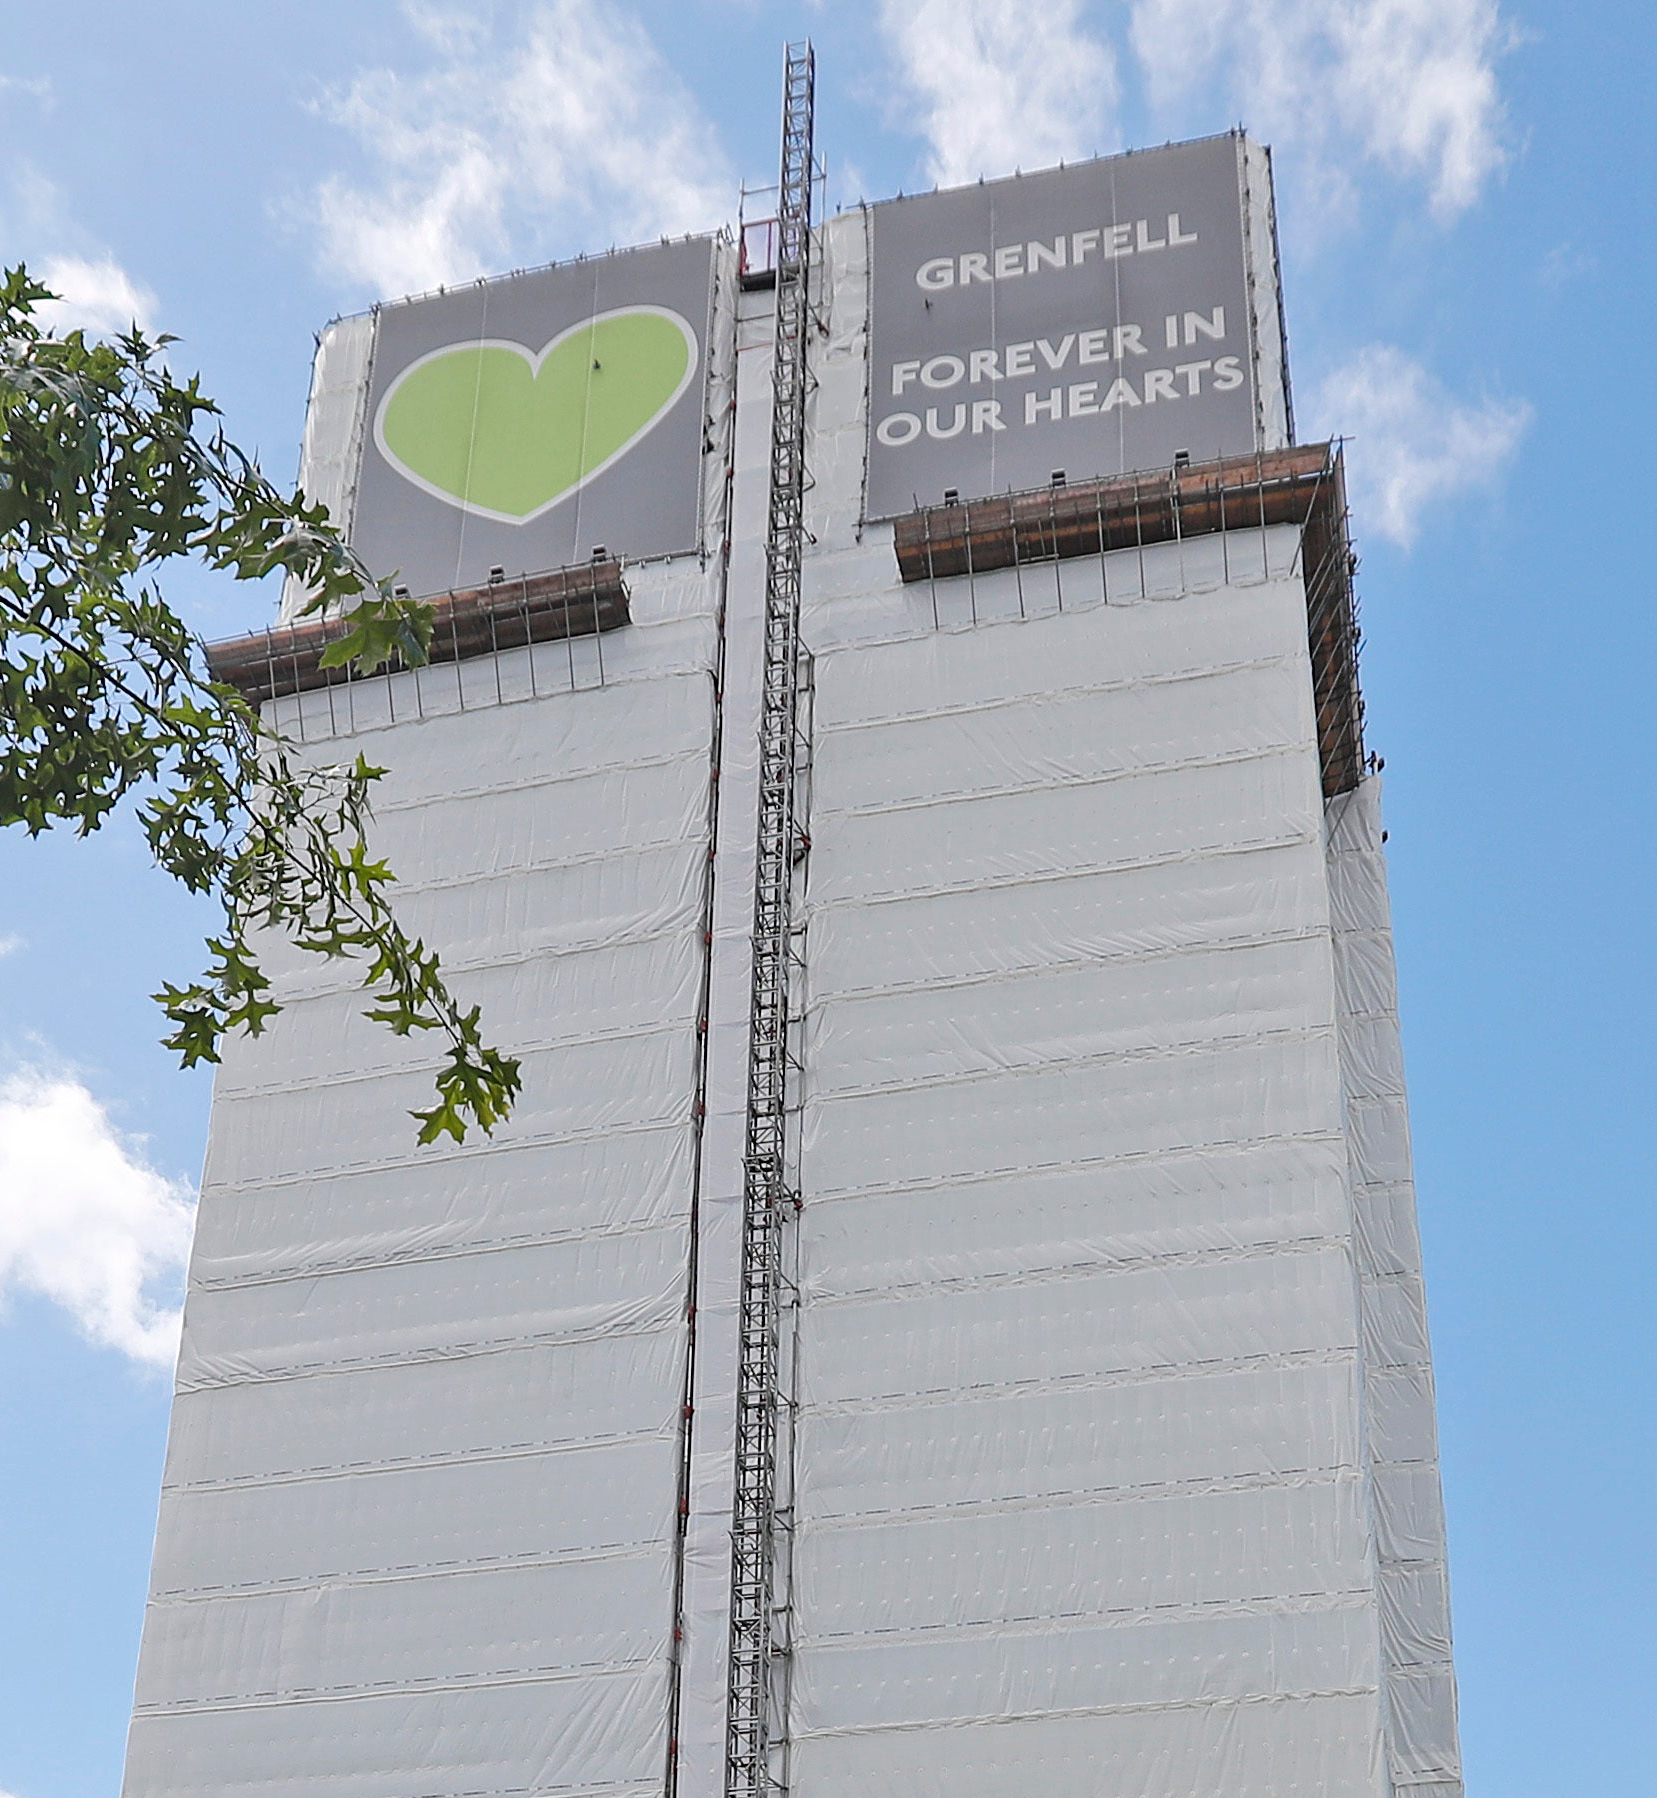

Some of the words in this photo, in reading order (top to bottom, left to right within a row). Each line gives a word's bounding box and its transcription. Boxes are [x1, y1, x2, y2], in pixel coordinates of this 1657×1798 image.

[915, 212, 1199, 291] GRENFELL
[892, 323, 1149, 396] FOREVER
[1164, 305, 1226, 349] IN
[876, 398, 1008, 448] OUR
[1023, 355, 1245, 425] HEARTS
